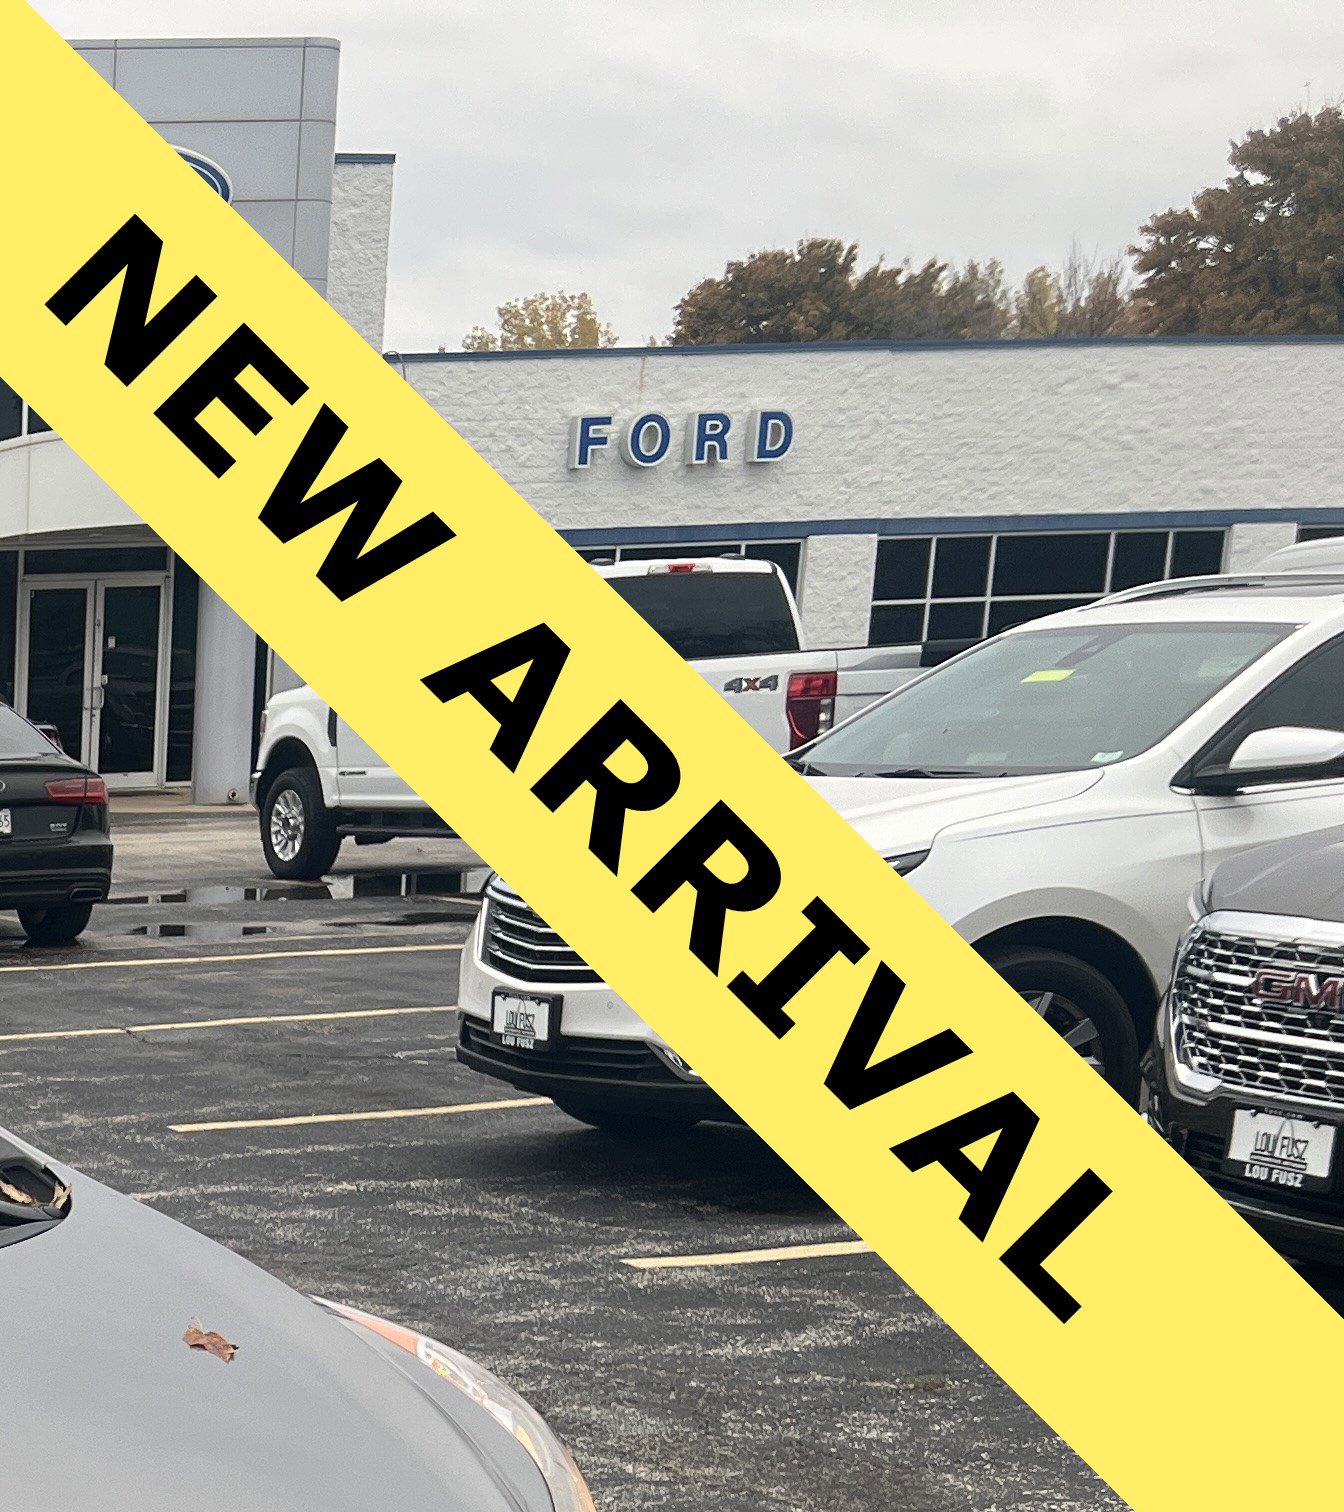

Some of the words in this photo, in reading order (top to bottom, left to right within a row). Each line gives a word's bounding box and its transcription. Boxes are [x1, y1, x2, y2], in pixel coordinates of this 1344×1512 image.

[575, 411, 794, 468] FORD
[1253, 968, 1344, 1009] GM
[1244, 1163, 1270, 1180] LOU
[1271, 1169, 1304, 1188] FUSZ
